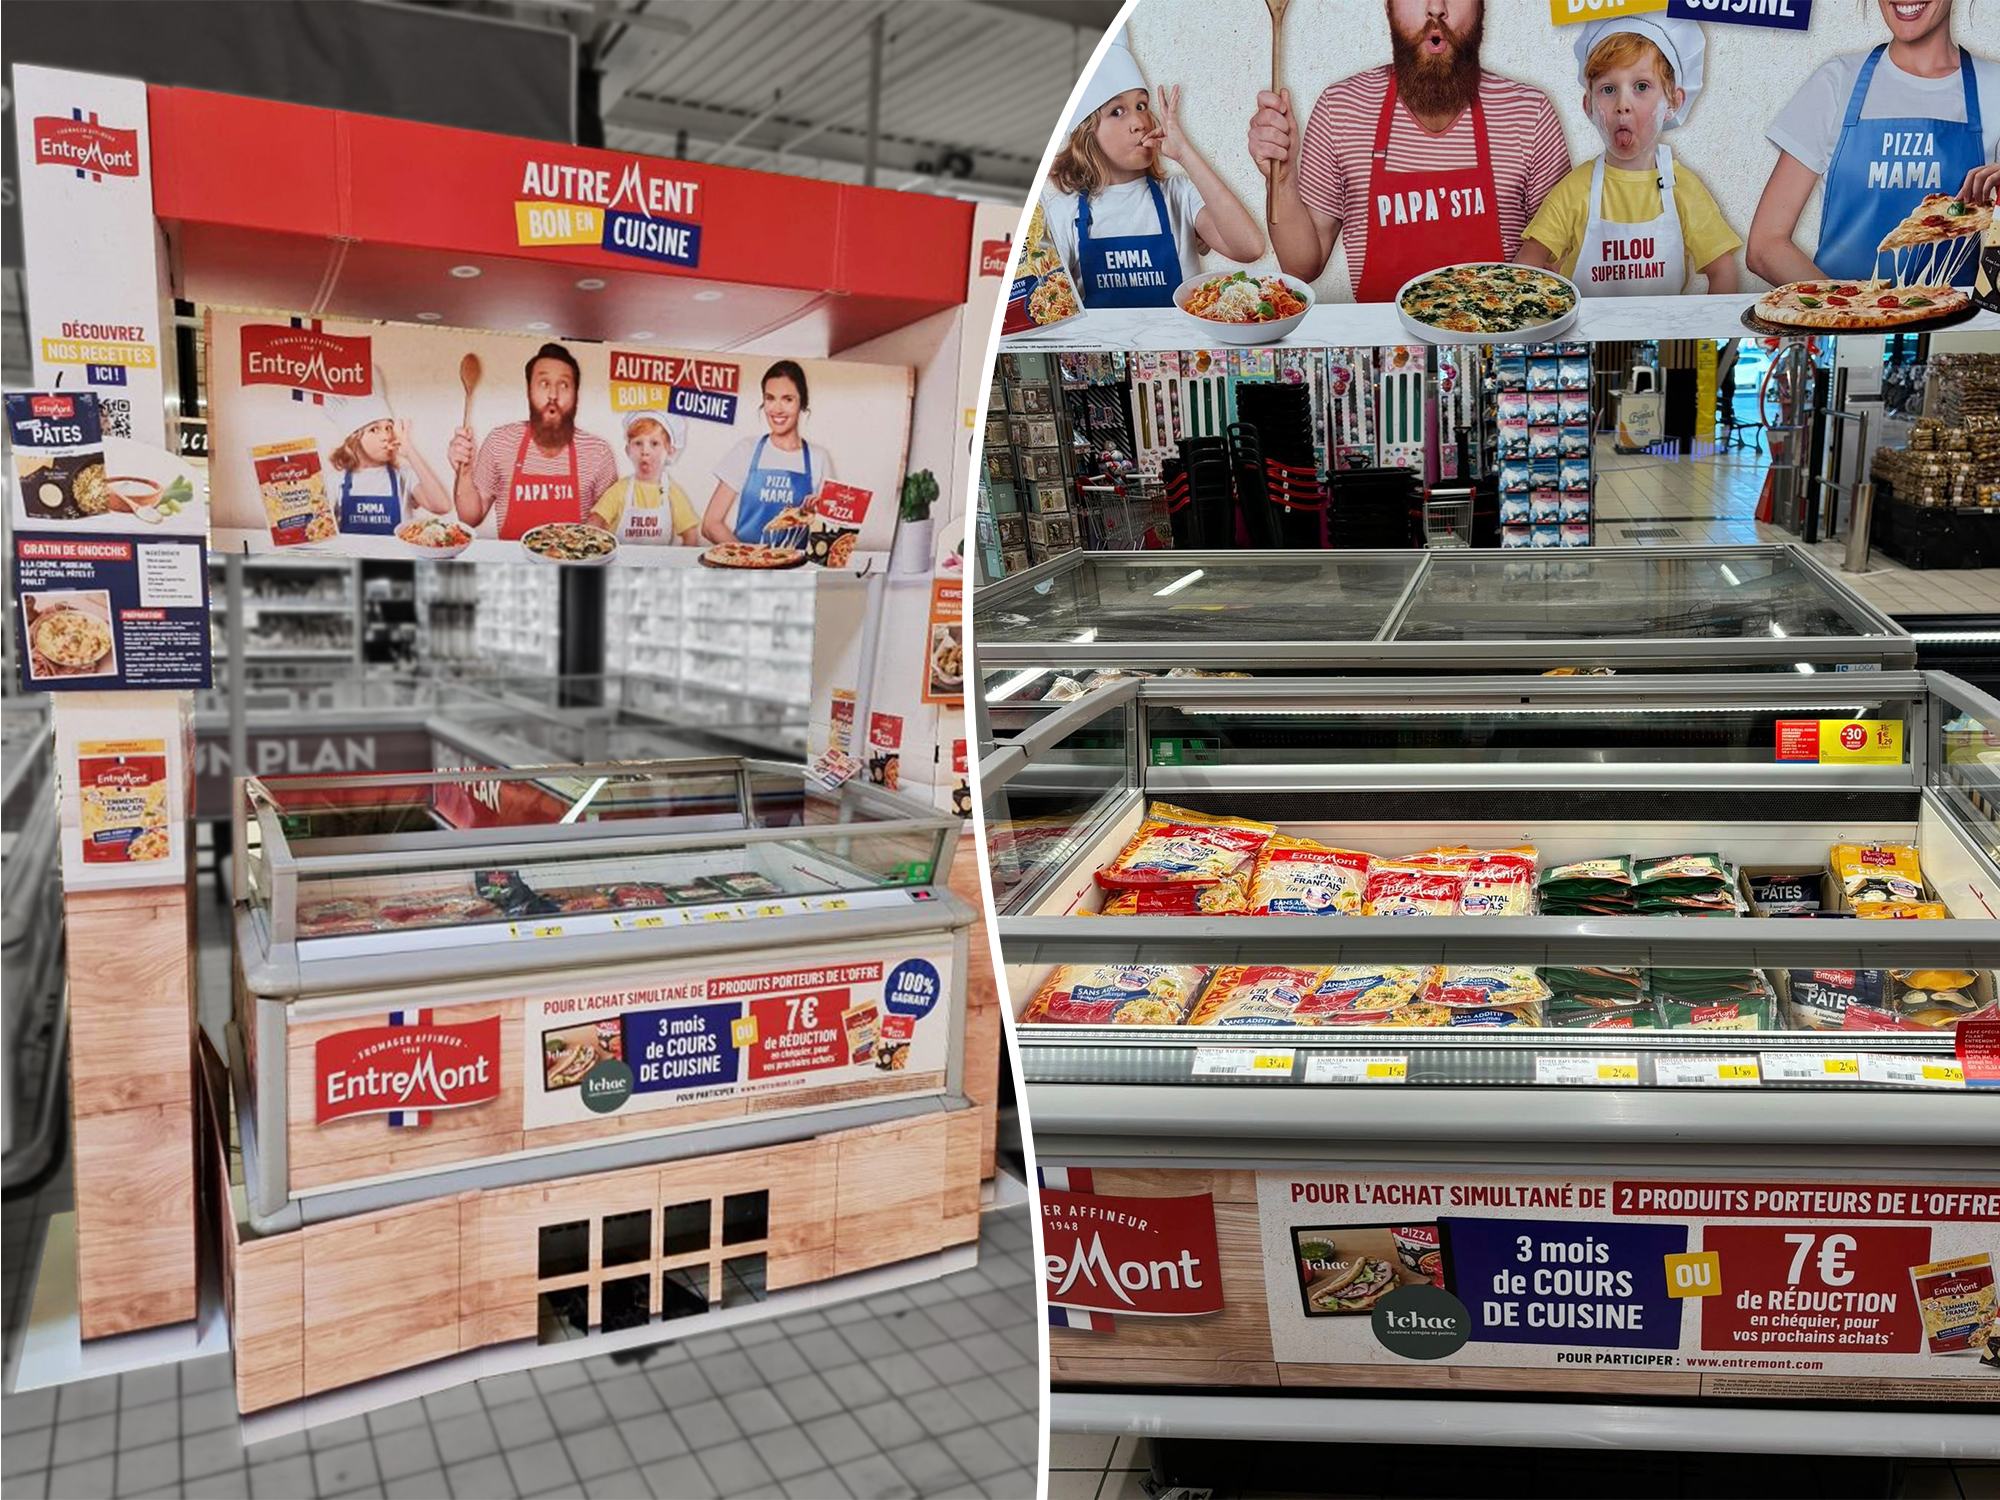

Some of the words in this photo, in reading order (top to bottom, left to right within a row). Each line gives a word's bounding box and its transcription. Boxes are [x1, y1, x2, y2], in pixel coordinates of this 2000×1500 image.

[1881, 133, 1935, 156] PIZZA
[41, 138, 133, 172] EntreMont
[1867, 161, 1942, 189] MAMA
[522, 161, 699, 219] AUTREMENT
[1377, 186, 1486, 228] PAPA'STA
[528, 209, 572, 239] BON
[576, 211, 594, 233] EN
[613, 217, 691, 258] CUISINE
[1105, 249, 1153, 270] EMMA
[1601, 237, 1655, 262] FILOU
[1096, 273, 1129, 289] EXTRA
[1131, 271, 1168, 288] MENTAL
[1591, 264, 1627, 282] SUPER
[1628, 261, 1666, 281] FILANT
[62, 320, 146, 342] DÉCOUVREZ
[47, 343, 78, 360] NOS
[81, 346, 153, 364] RECETTES
[95, 367, 113, 381] ICI
[249, 351, 365, 390] EntreMont
[615, 356, 737, 391] AUTREMENT
[618, 386, 648, 406] BON
[650, 386, 662, 401] EN
[675, 390, 730, 420] CUISINE
[33, 424, 83, 443] PÂTES
[766, 475, 791, 488] PIZZA
[516, 484, 574, 502] PAPA'STA
[760, 488, 794, 504] MAMA
[356, 503, 385, 514] EMMA
[827, 506, 854, 521] PIZZA
[349, 514, 368, 524] EXTRA
[369, 514, 392, 525] MENTAL
[631, 516, 658, 527] FILOU
[23, 543, 62, 555] GRATIN
[63, 545, 76, 556] DE
[77, 545, 128, 557] GNOCCHIS
[21, 578, 46, 586] POULET
[257, 737, 376, 778] PLAN
[1291, 852, 1358, 867] EntreMont
[1862, 856, 1894, 867] EntreMont
[1761, 885, 1802, 900] PÂTES
[897, 971, 934, 994] 100%
[1815, 971, 1854, 985] EntreMont
[543, 1000, 576, 1015] POUR
[578, 992, 626, 1011] L'ACHAT
[627, 984, 688, 1006] SIMULTANÉ
[690, 984, 704, 998] DE
[710, 983, 718, 996] 2
[718, 975, 770, 995] PRODUITS
[772, 970, 825, 990] PORTEURS
[827, 969, 840, 983] DE
[840, 966, 880, 982] L'OFFRE
[891, 991, 932, 1006] GAGNANT
[1077, 987, 1099, 997] SANS
[1807, 990, 1858, 1010] PÂTES
[785, 996, 819, 1031] 7€
[1473, 1011, 1504, 1019] ADDITIF
[1693, 1008, 1737, 1022] EntreMont
[658, 1018, 668, 1036] 3
[670, 1014, 706, 1034] mois
[736, 1025, 754, 1040] OU
[359, 1035, 411, 1061] FROMAGER
[415, 1033, 463, 1048] AFFINEUR
[646, 1041, 664, 1060] de
[666, 1033, 717, 1056] COURS
[764, 1036, 777, 1050] de
[779, 1028, 838, 1048] RÉDUCTION
[640, 1063, 660, 1083] DE
[662, 1055, 722, 1080] CUISINE
[763, 1061, 775, 1070] vos
[326, 1050, 490, 1104] EntreMont
[589, 1077, 627, 1092] tchac
[1291, 1182, 1349, 1204] POUR
[1354, 1184, 1445, 1206] L'ACHAT
[1450, 1183, 1573, 1208] SIMULTANÉ
[1578, 1188, 1606, 1209] DE
[1620, 1188, 1633, 1210] 2
[1638, 1189, 1749, 1211] PRODUITS
[1753, 1190, 1871, 1214] PORTEURS
[1876, 1192, 1906, 1214] DE
[1910, 1193, 2000, 1216] L'OFFRE
[1050, 1221, 1079, 1231] 1948
[1069, 1205, 1149, 1231] AFFINEUR
[1401, 1227, 1434, 1243] PIZZA
[1516, 1235, 1533, 1262] 3
[1540, 1236, 1610, 1264] mois
[1306, 1258, 1349, 1271] tchac
[1784, 1233, 1858, 1287] 7€
[1493, 1268, 1527, 1295] de
[1533, 1269, 1633, 1298] COURS
[1675, 1262, 1711, 1288] OU
[1934, 1281, 1978, 1296] EntreMont
[1736, 1290, 1763, 1311] de
[1768, 1286, 1897, 1313] RÉDUCTION
[1940, 1301, 1981, 1312] L'EMMENTAL
[1386, 1310, 1457, 1330] tchac
[1483, 1301, 1520, 1327] DE
[1527, 1302, 1644, 1330] CUISINE
[1945, 1307, 1978, 1316] FRANÇAIS
[1750, 1315, 1769, 1326] en
[1771, 1313, 1841, 1331] chéquier,
[1843, 1317, 1880, 1330] pour
[1733, 1331, 1759, 1342] vos
[1761, 1328, 1836, 1346] prochains
[1557, 1353, 1593, 1364] POUR
[1595, 1354, 1673, 1366] PARTICIPER
[1686, 1357, 1824, 1371] www.entremont.com
